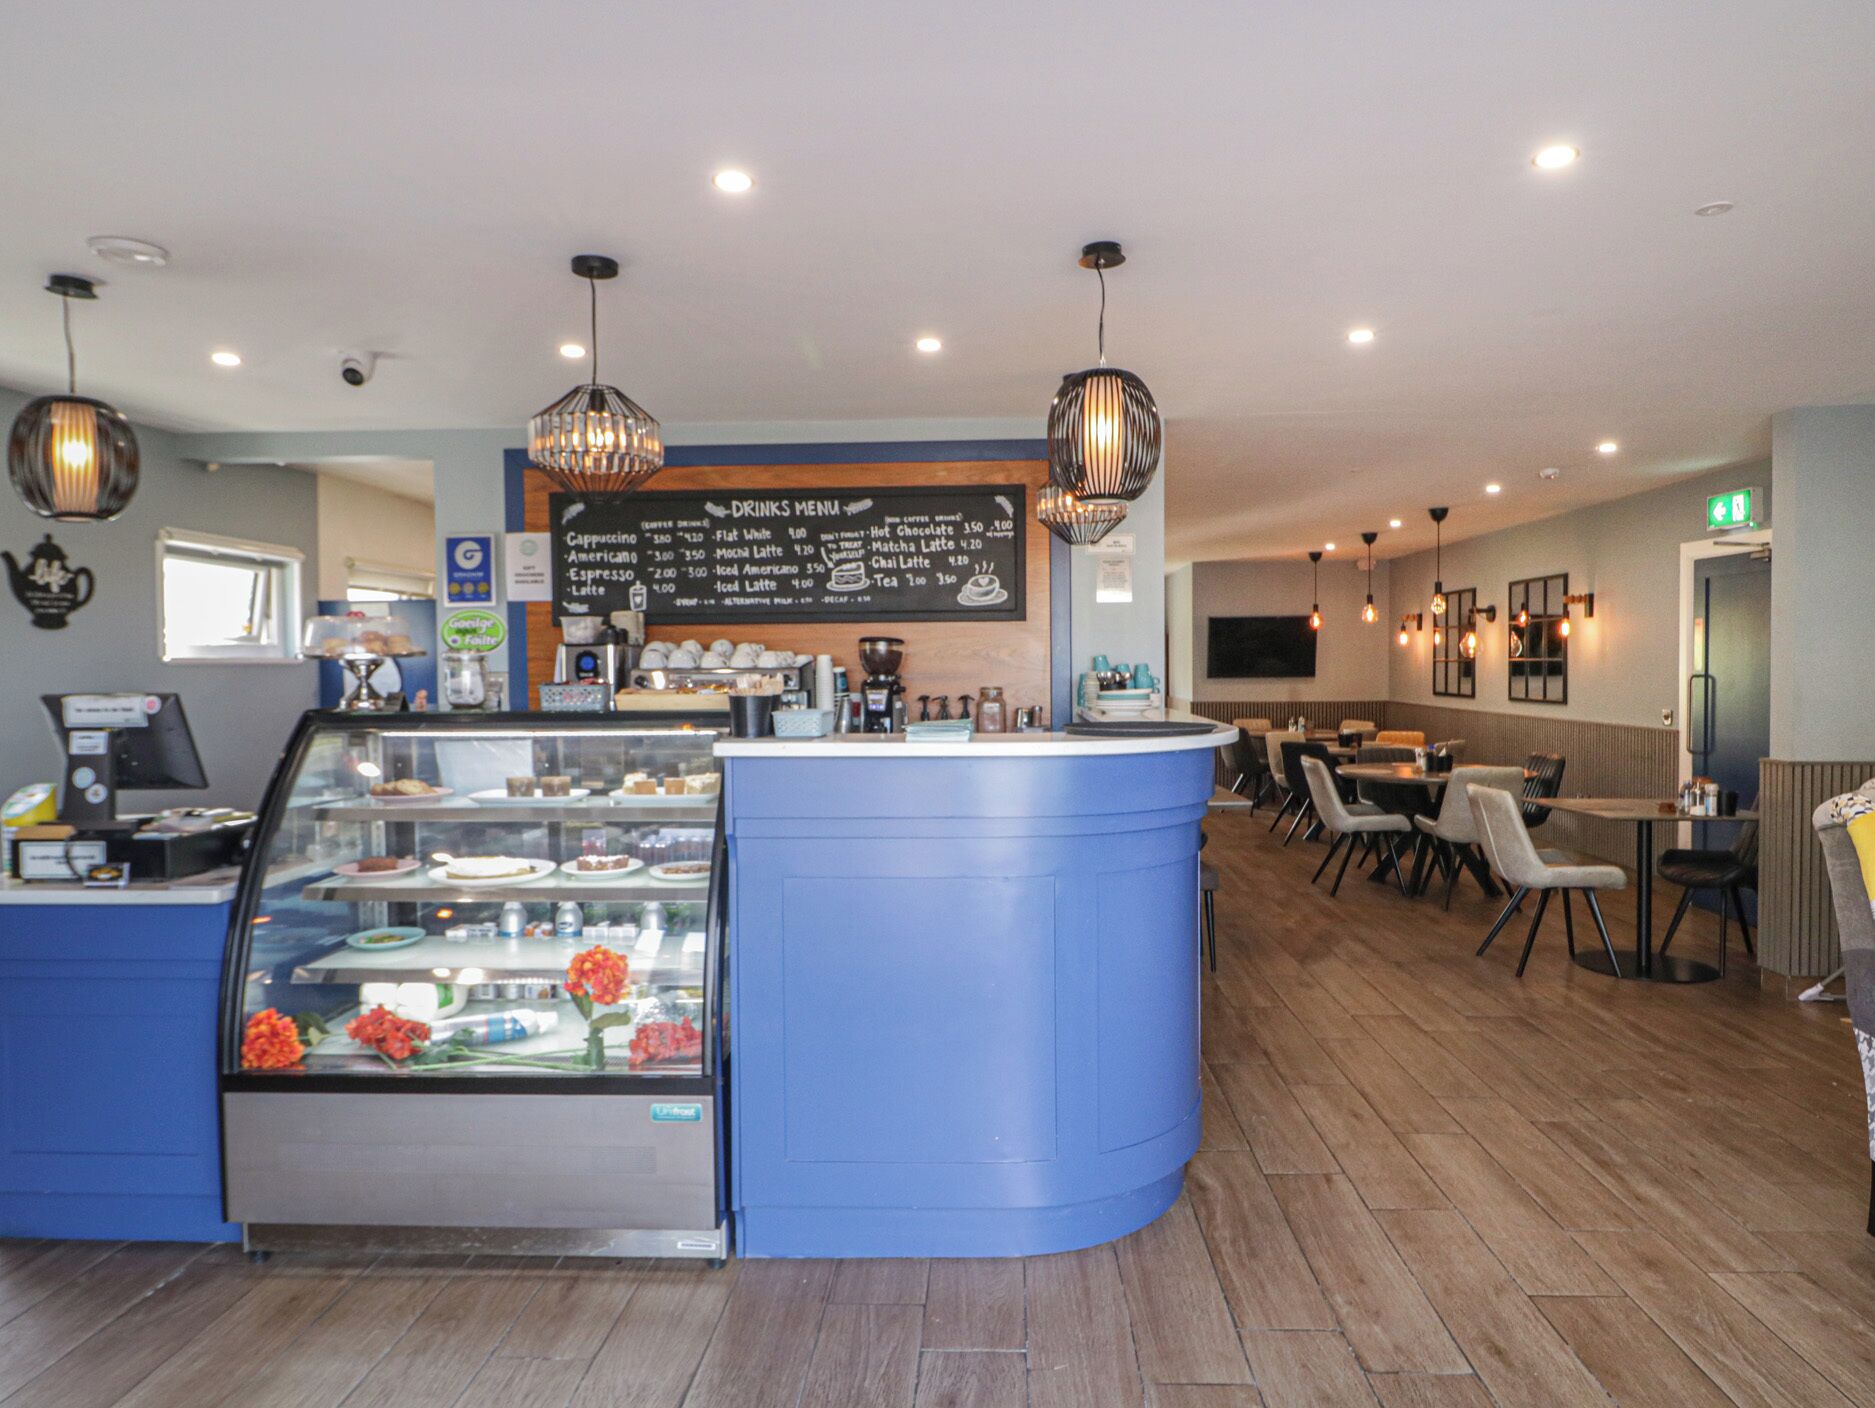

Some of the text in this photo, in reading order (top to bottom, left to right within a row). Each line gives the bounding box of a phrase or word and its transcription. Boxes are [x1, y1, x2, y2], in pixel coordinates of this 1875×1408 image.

[731, 499, 840, 517] DRINKS MENU
[716, 528, 738, 542] Flat
[743, 528, 772, 540] White
[871, 525, 891, 538] Hot
[897, 524, 954, 536] Chocolate
[566, 531, 637, 548] Cappuccino
[872, 540, 916, 553] Matcha
[921, 536, 956, 553] Latte
[568, 550, 638, 564] Americano
[716, 546, 750, 559] Mocha
[753, 544, 783, 558] Latte
[872, 555, 897, 569] Chai
[900, 555, 931, 569] Latte
[569, 567, 635, 585] Espresso
[716, 563, 739, 576] Iced
[743, 563, 799, 576] Americano
[717, 580, 740, 592] Iced
[745, 578, 777, 592] Latte
[873, 573, 898, 588] Tea
[572, 584, 606, 596] Latte
